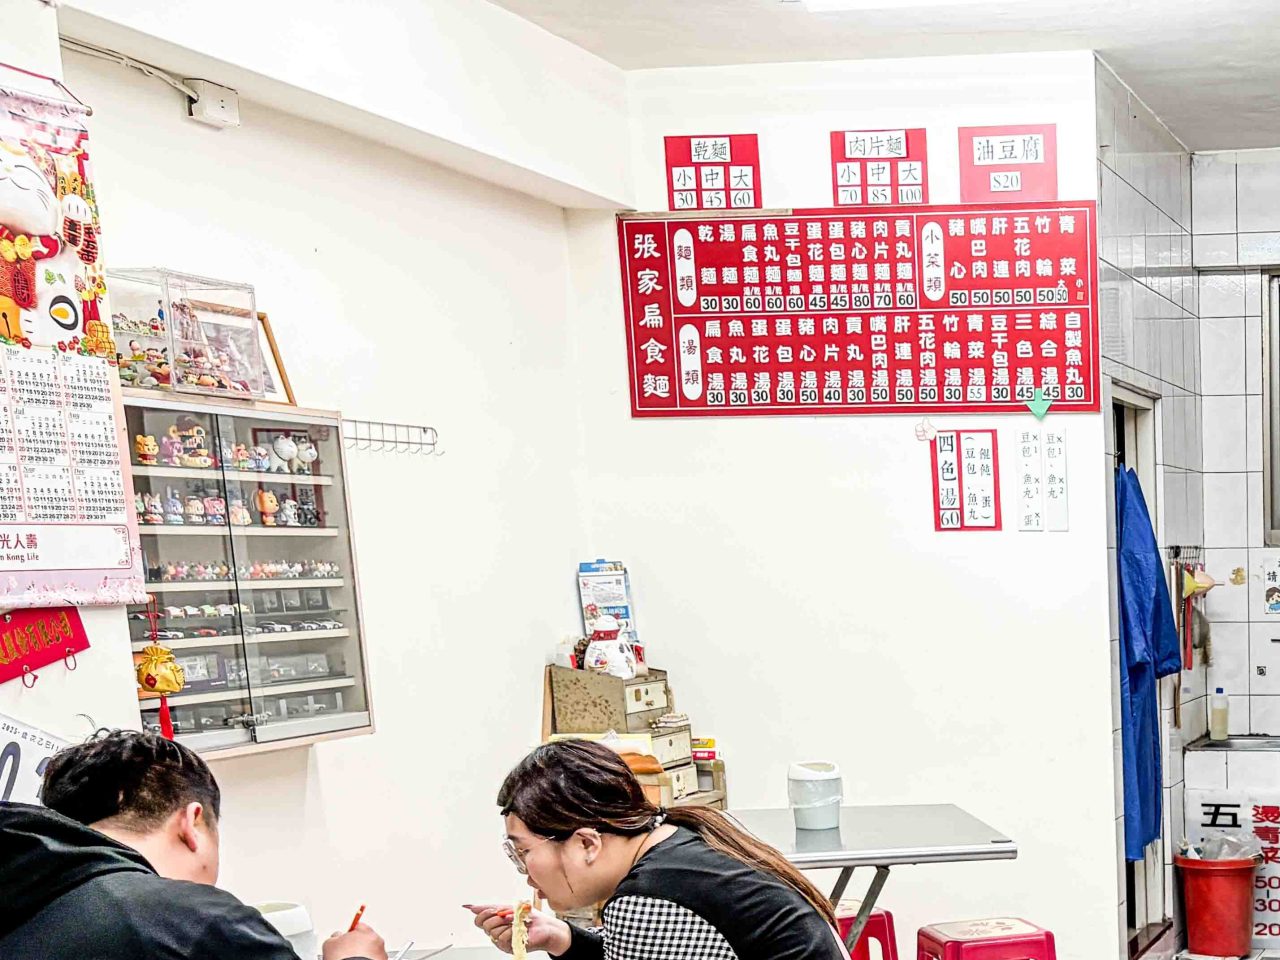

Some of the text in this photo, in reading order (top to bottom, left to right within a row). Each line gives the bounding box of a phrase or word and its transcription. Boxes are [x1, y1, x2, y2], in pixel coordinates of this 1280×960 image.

[693, 140, 727, 161] 乾麵
[849, 135, 903, 156] 肉片麵
[977, 136, 1040, 161] 油豆腐
[677, 168, 749, 187] 小 中 大
[841, 163, 918, 183] 小 中 大
[678, 192, 750, 207] 30 45 60
[841, 189, 921, 202] 70 85 100
[698, 225, 717, 284] 乾麵
[719, 224, 738, 284] 湯麵
[741, 224, 759, 283] 扁食麵
[763, 223, 781, 283] 魚丸麵
[807, 222, 824, 282] 蛋花麵
[828, 222, 846, 281] 蛋包麵
[850, 221, 868, 280] 豬心麵
[873, 221, 891, 280] 肉片麵
[895, 220, 913, 280] 貢丸麵
[948, 218, 967, 279] 豬心
[970, 218, 988, 278] 嘴巴肉
[992, 217, 1010, 278] 肝連
[1014, 217, 1031, 277] 五花肉
[1035, 216, 1053, 276] 竹輪
[1059, 215, 1076, 275] 青菜
[677, 245, 694, 292] 麵類
[925, 229, 942, 292] 小菜類
[1076, 279, 1084, 288] 小
[702, 298, 717, 310] 30
[724, 298, 738, 309] 30
[745, 297, 760, 309] 60
[767, 297, 782, 308] 60
[788, 297, 803, 308] 60
[810, 296, 826, 308] 45
[831, 296, 847, 307] 45
[854, 295, 870, 307] 80
[876, 295, 891, 306] 70
[899, 294, 914, 306] 60
[951, 293, 967, 304] 50
[973, 292, 989, 303] 50
[994, 291, 1010, 303] 50
[1016, 291, 1032, 302] 50
[1038, 290, 1054, 302] 50
[1057, 289, 1067, 301] 50
[634, 233, 670, 398] 張家扁食麵
[705, 320, 724, 390] 扁食湯
[728, 319, 748, 390] 魚丸湯
[751, 319, 771, 389] 蛋花湯
[775, 319, 794, 389] 蛋包湯
[798, 318, 817, 389] 豬心湯
[823, 317, 841, 388] 肉片湯
[846, 317, 864, 388] 貢丸湯
[870, 316, 889, 387] 嘴巴肉湯
[894, 316, 913, 386] 肝連湯
[918, 314, 937, 386] 五花肉湯
[943, 314, 962, 386] 竹輪湯
[967, 314, 986, 386] 青菜湯
[1015, 313, 1034, 385] 三色湯
[1040, 313, 1058, 385] 綜合湯
[1065, 312, 1083, 384] 自製魚丸
[683, 340, 699, 385] 湯類
[709, 392, 723, 403] 30
[731, 392, 746, 403] 30
[753, 391, 768, 401] 30
[778, 390, 793, 400] 30
[801, 390, 817, 401] 50
[825, 390, 840, 401] 40
[849, 389, 864, 400] 30
[872, 389, 888, 400] 50
[897, 389, 913, 400] 50
[920, 388, 936, 399] 50
[945, 388, 961, 400] 30
[969, 388, 982, 399] 55
[993, 388, 1008, 399] 30
[1017, 387, 1033, 398] 45
[1043, 386, 1059, 398] 45
[1067, 387, 1083, 398] 30
[939, 435, 957, 506] 四色湯
[941, 511, 959, 526] 60
[6, 553, 25, 563] Kong
[27, 552, 39, 560] Life
[1201, 803, 1241, 828] 五
